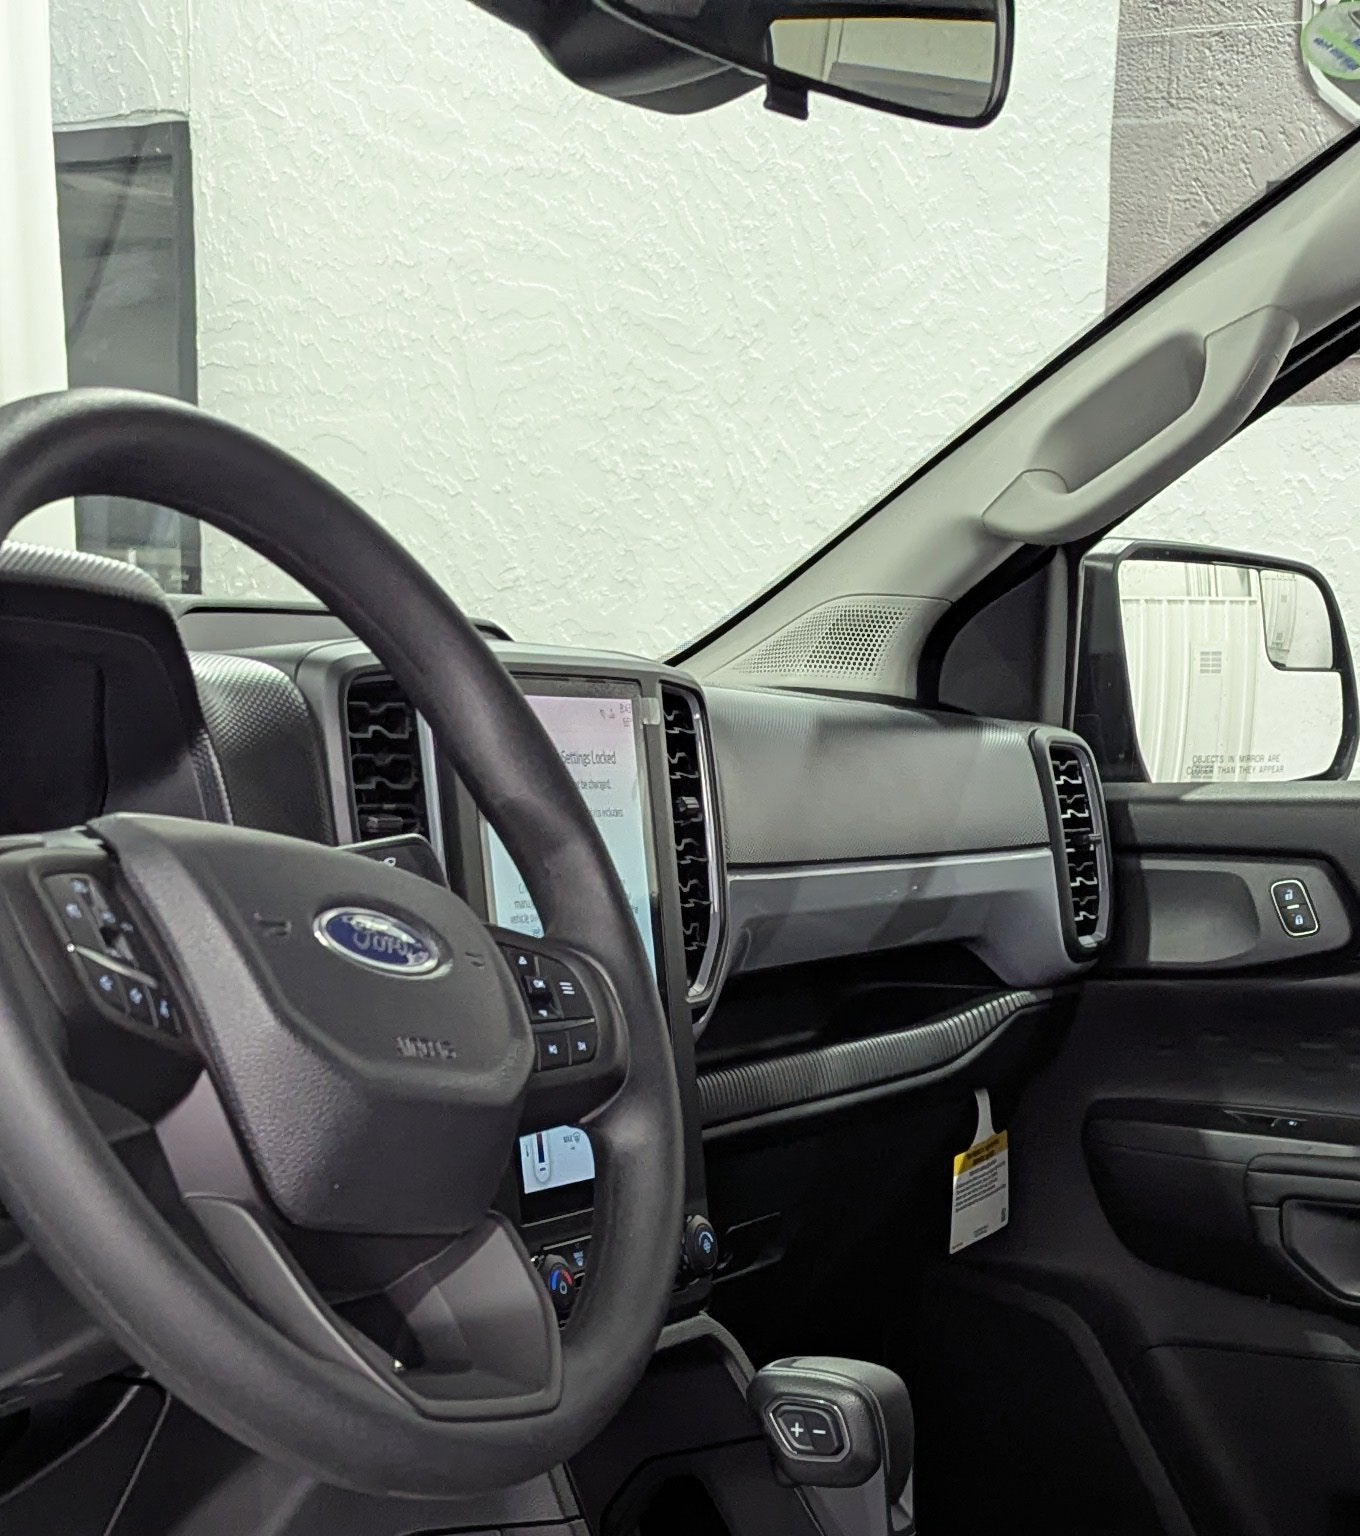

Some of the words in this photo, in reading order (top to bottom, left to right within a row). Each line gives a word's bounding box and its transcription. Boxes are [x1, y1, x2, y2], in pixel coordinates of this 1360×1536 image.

[591, 749, 617, 765] Locked
[1192, 754, 1225, 763] OBJECTS
[1228, 754, 1235, 763] IN
[1239, 754, 1265, 763] MIRROR
[1267, 753, 1281, 762] ARE
[1218, 765, 1236, 774] THAN
[1239, 765, 1256, 774] THEY
[1258, 764, 1285, 774] APPEAR
